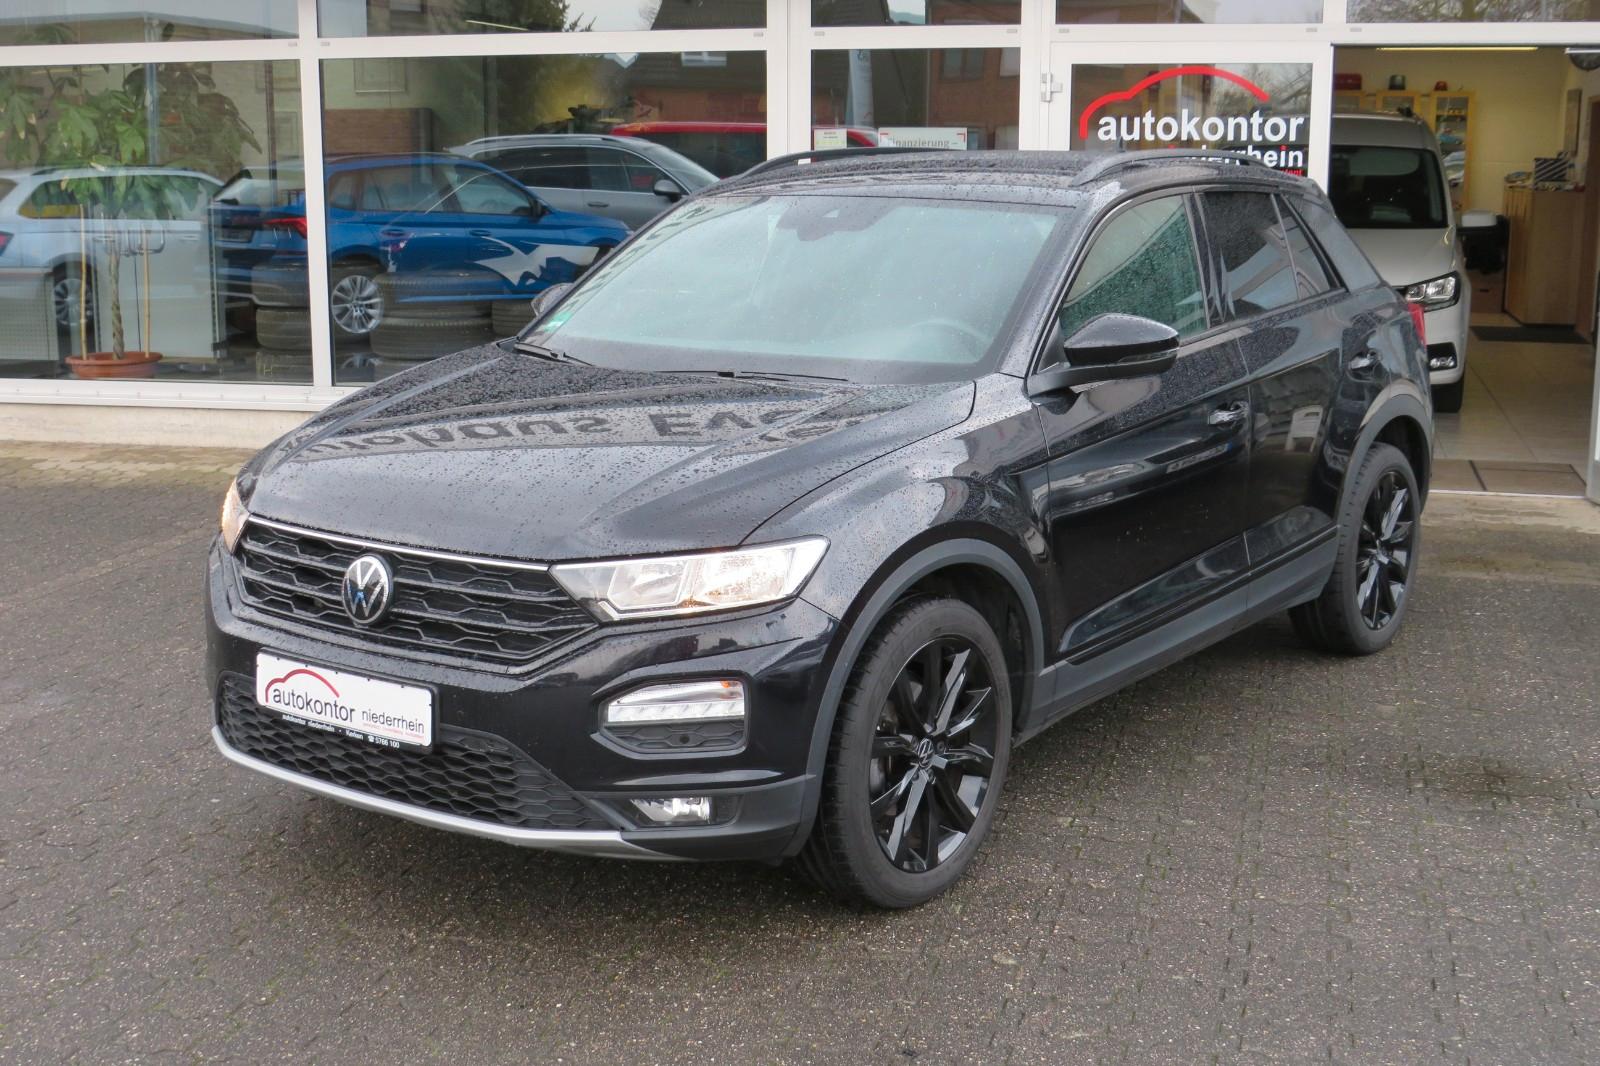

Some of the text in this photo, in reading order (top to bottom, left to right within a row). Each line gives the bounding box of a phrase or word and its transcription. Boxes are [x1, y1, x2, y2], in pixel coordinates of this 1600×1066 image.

[1097, 108, 1305, 142] autokontor
[888, 136, 950, 149] inanzierung
[273, 688, 355, 723] autokontor
[361, 708, 425, 734] niederrhein
